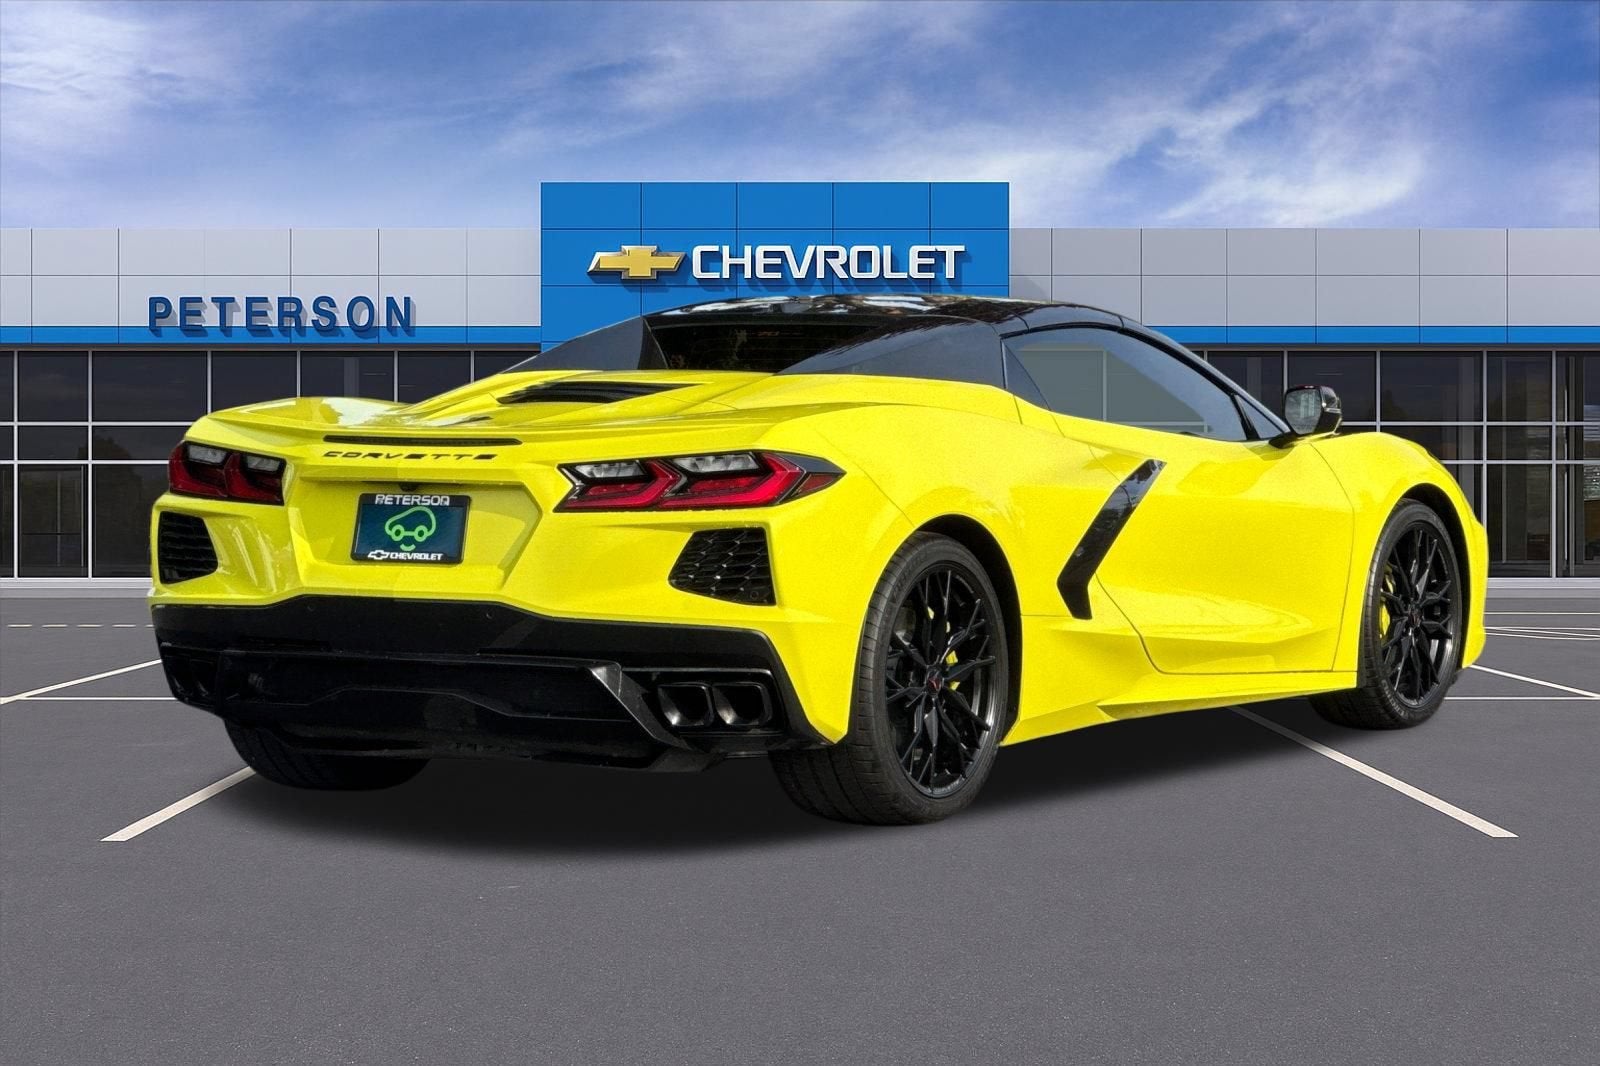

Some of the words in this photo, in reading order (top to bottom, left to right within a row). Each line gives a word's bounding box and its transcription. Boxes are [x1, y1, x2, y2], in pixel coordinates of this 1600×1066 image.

[692, 244, 966, 280] CHEVROLET
[148, 295, 412, 332] PETERSON
[322, 450, 499, 461] CORVETTE
[374, 494, 450, 507] PETERSON
[389, 551, 444, 561] CHEVROLET
